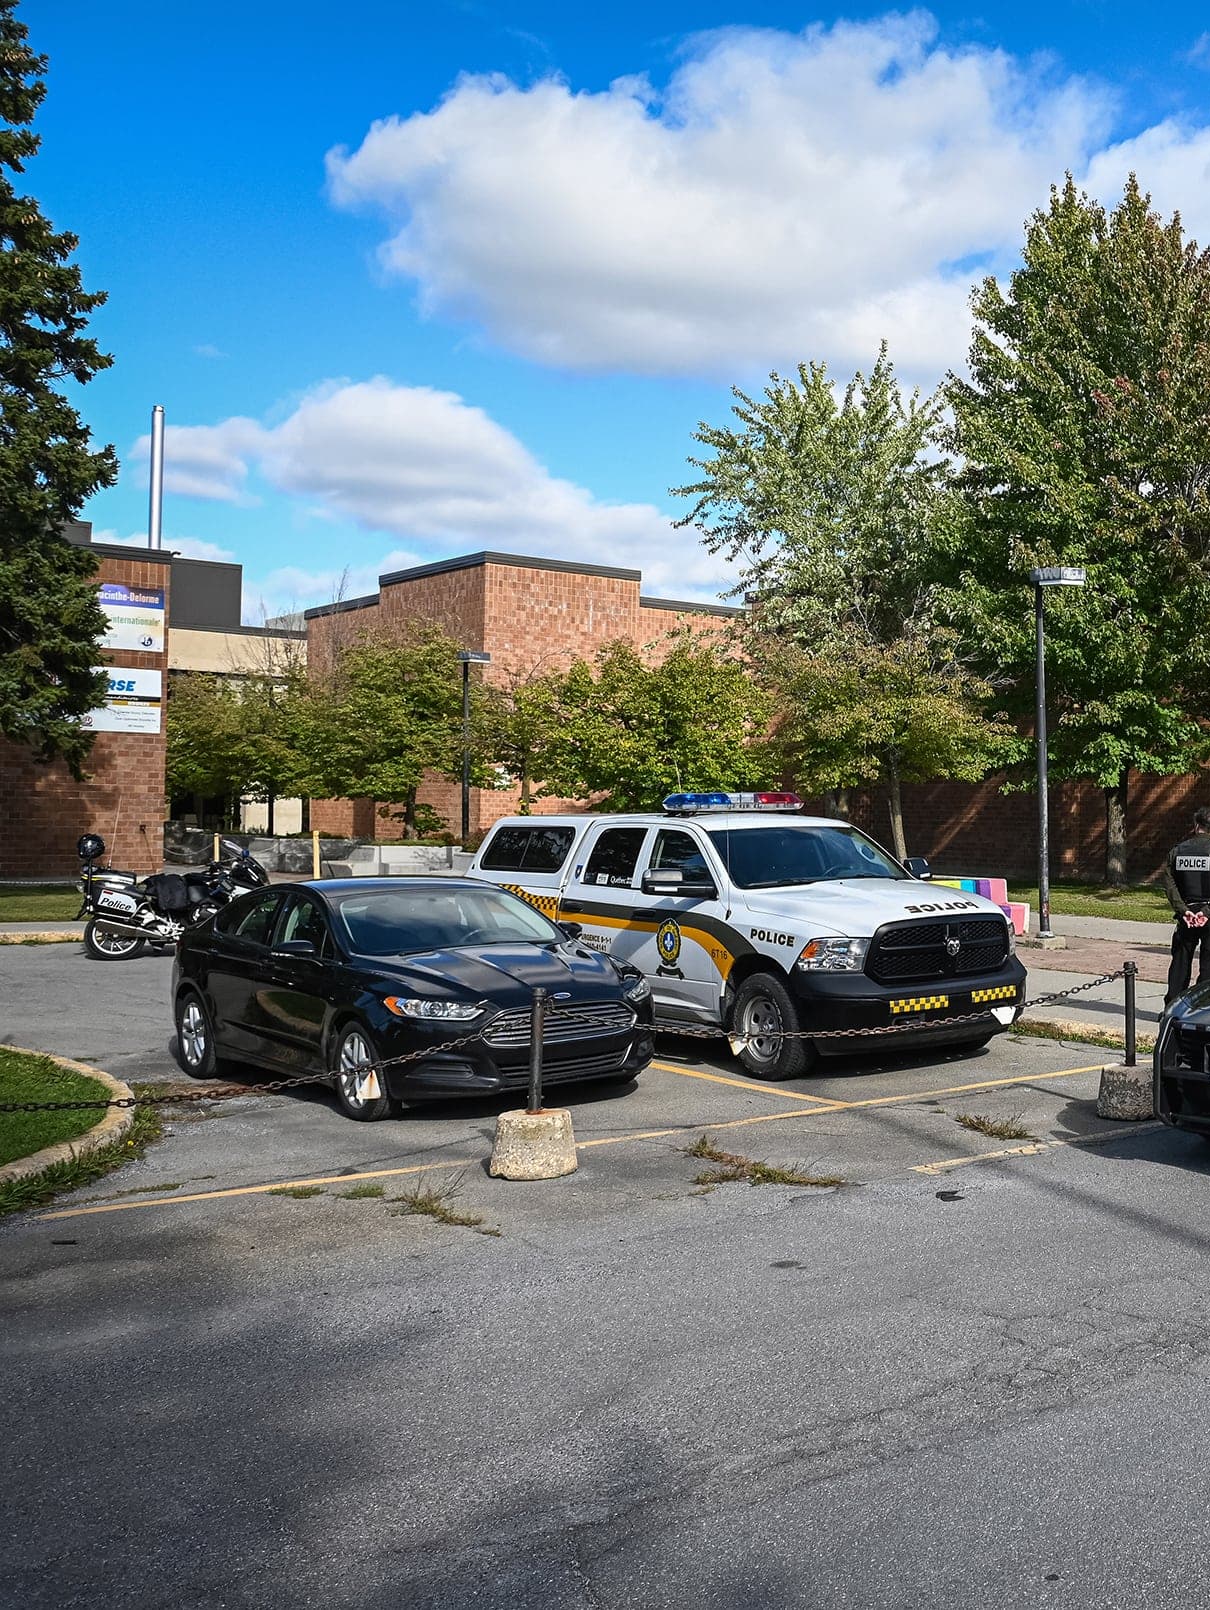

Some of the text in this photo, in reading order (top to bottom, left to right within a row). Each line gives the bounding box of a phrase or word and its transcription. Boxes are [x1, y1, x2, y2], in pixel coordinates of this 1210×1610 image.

[1179, 859, 1206, 868] POLICE
[100, 897, 132, 910] Police
[751, 928, 795, 947] POLICE
